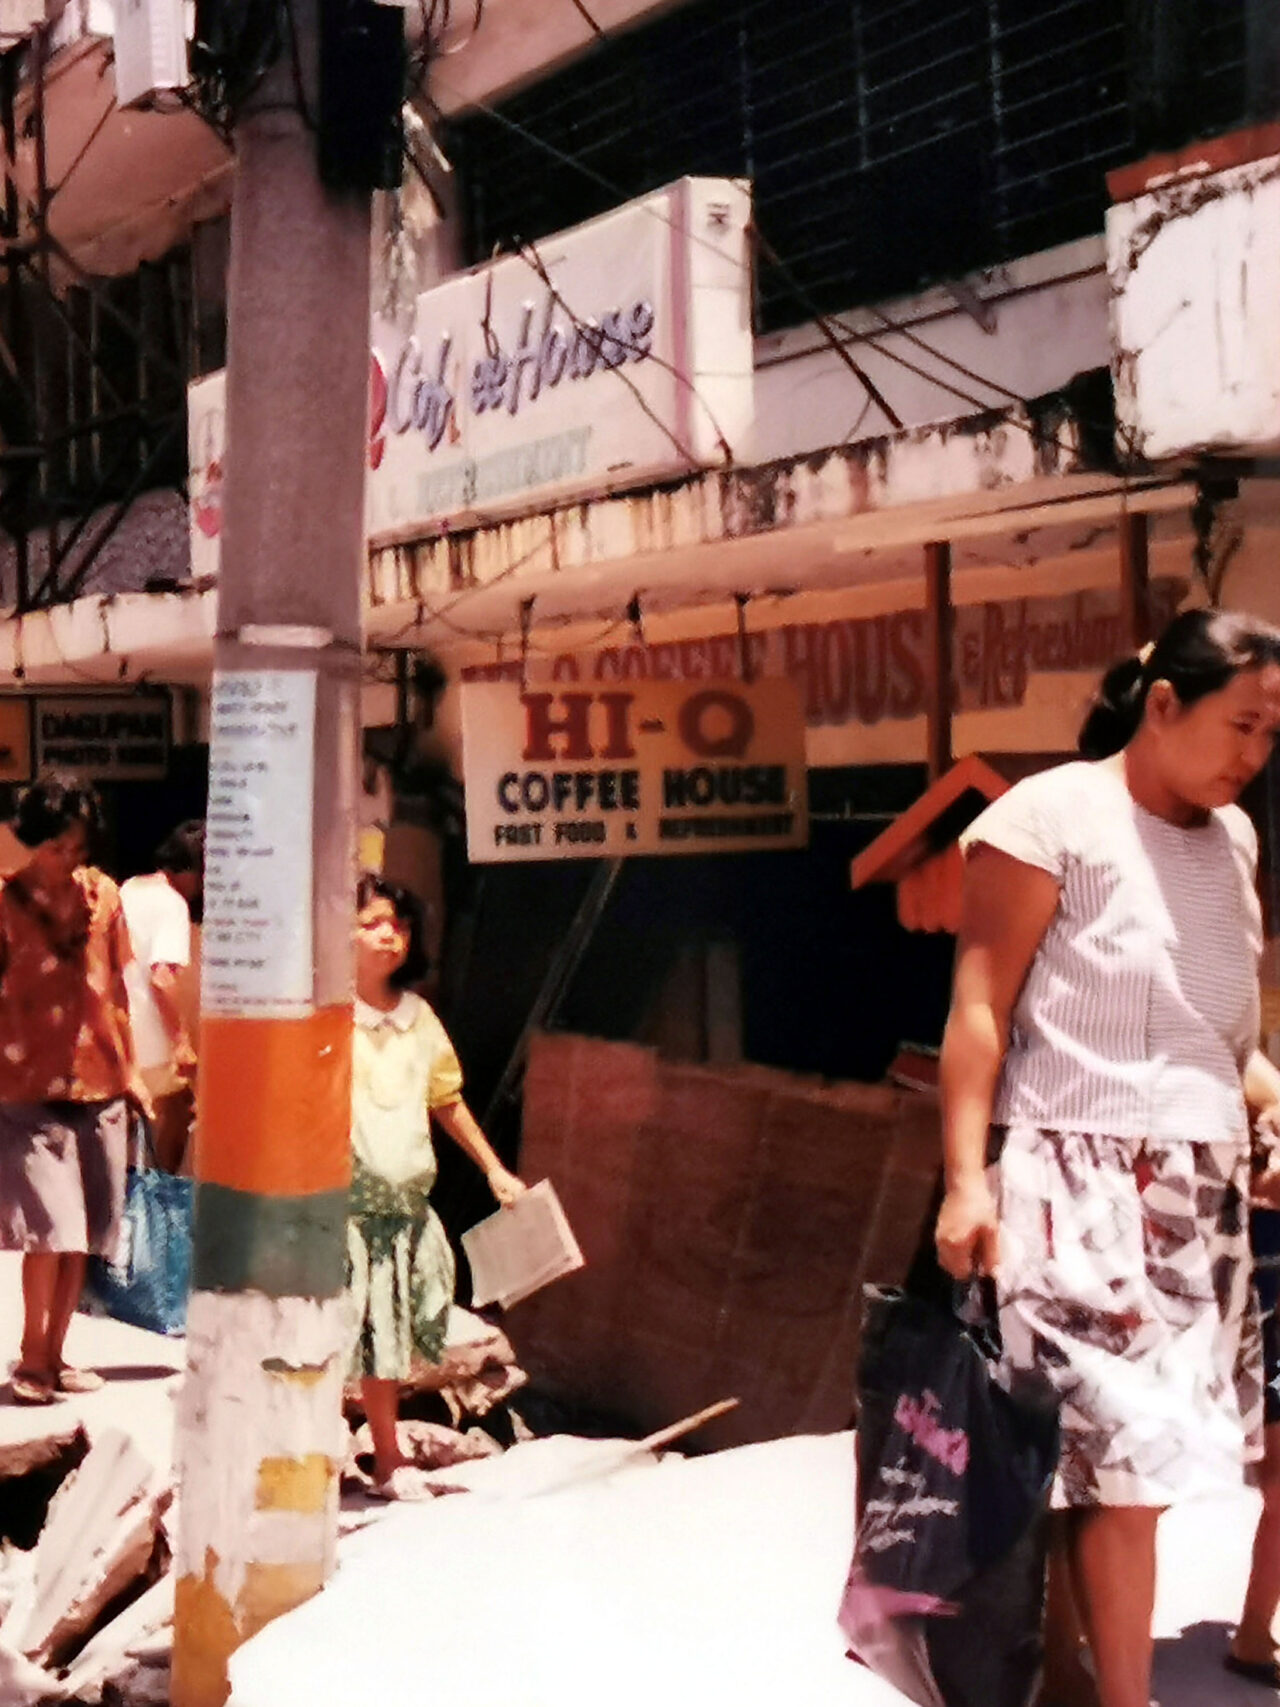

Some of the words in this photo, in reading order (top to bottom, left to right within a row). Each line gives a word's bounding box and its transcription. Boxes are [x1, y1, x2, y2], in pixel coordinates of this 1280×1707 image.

[386, 332, 508, 452] Cofee
[783, 609, 928, 724] HOUS
[520, 690, 755, 761] HI-Q
[497, 770, 639, 814] COFFEE
[663, 764, 787, 809] HOUSE
